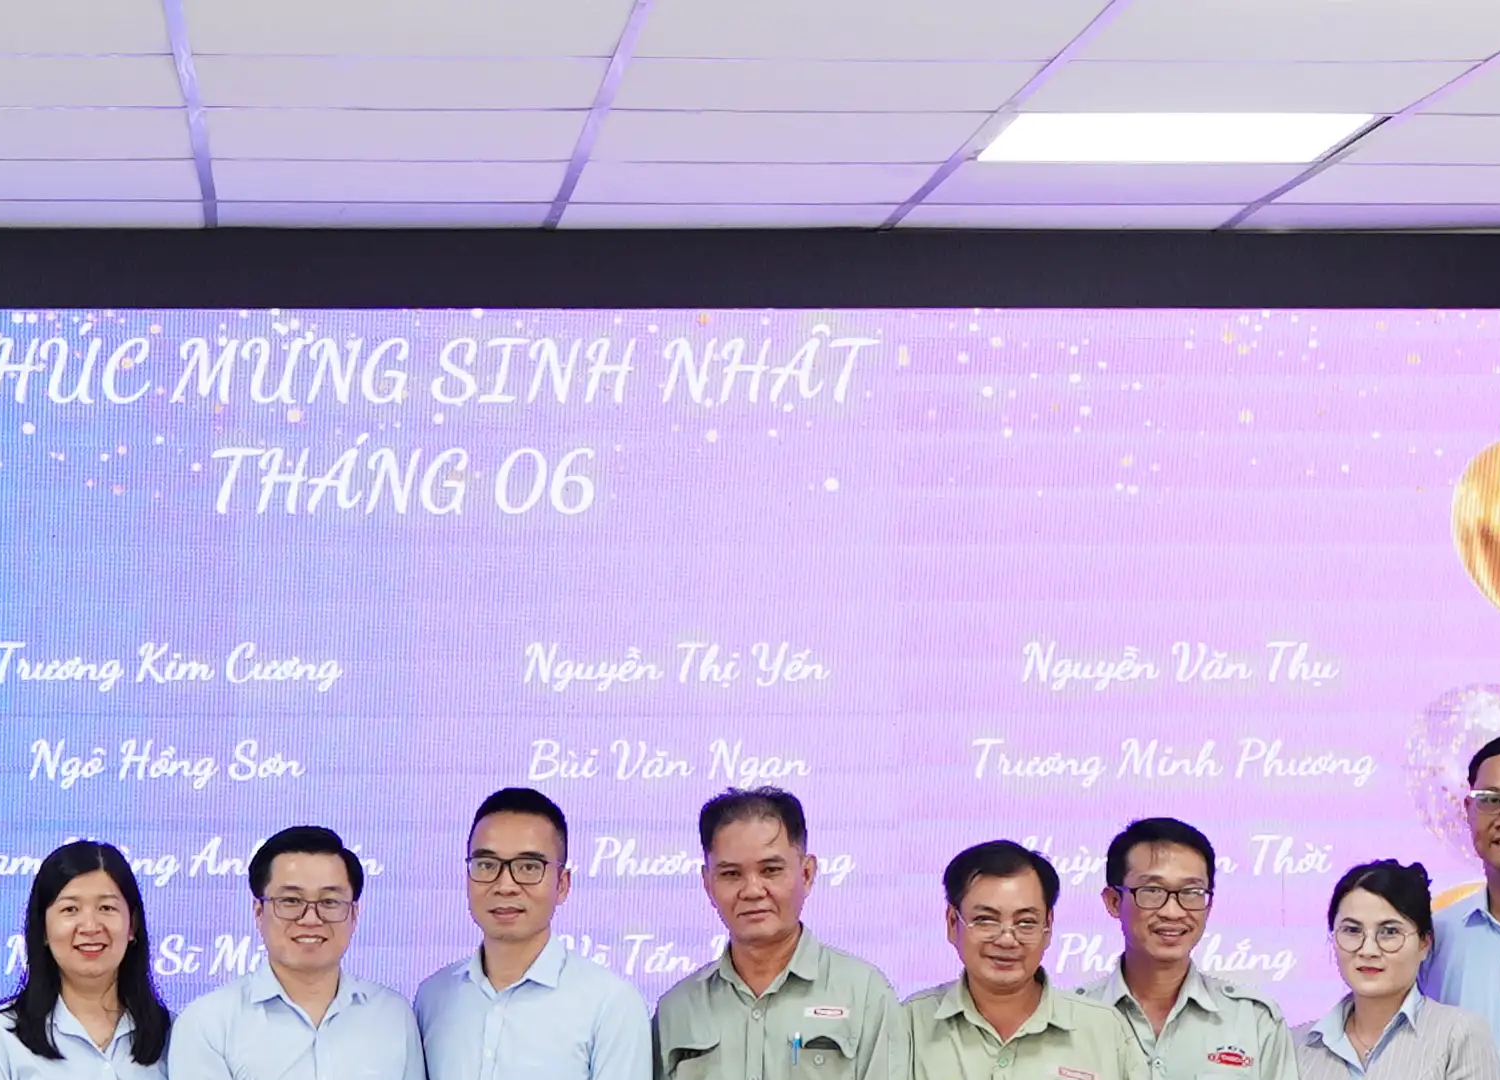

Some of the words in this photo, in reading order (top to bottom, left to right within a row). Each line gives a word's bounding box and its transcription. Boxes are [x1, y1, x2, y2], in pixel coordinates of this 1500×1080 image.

[169, 322, 409, 404] MỪNG
[431, 337, 637, 405] SINH
[661, 324, 880, 411] NHẬT
[211, 433, 469, 515] THÁNG
[494, 447, 595, 515] 06
[135, 641, 216, 684] Kim
[225, 641, 344, 693] Cương
[677, 642, 742, 688] Thị
[751, 641, 832, 687] Yến
[1022, 640, 1161, 692] Nguyễn
[1171, 641, 1253, 683] Văn
[1265, 641, 1340, 688] Thụ
[28, 738, 109, 790] Ngô
[119, 738, 220, 790] Hồng
[228, 739, 306, 781] Sơn
[527, 739, 601, 781] Bùi
[610, 739, 696, 781] Văn
[972, 738, 1107, 789] Trương
[1117, 738, 1225, 780] Minh
[1235, 738, 1379, 788] Phương
[588, 836, 703, 878] Phươn
[1251, 834, 1333, 876] Thời
[1195, 934, 1297, 981] hắng
